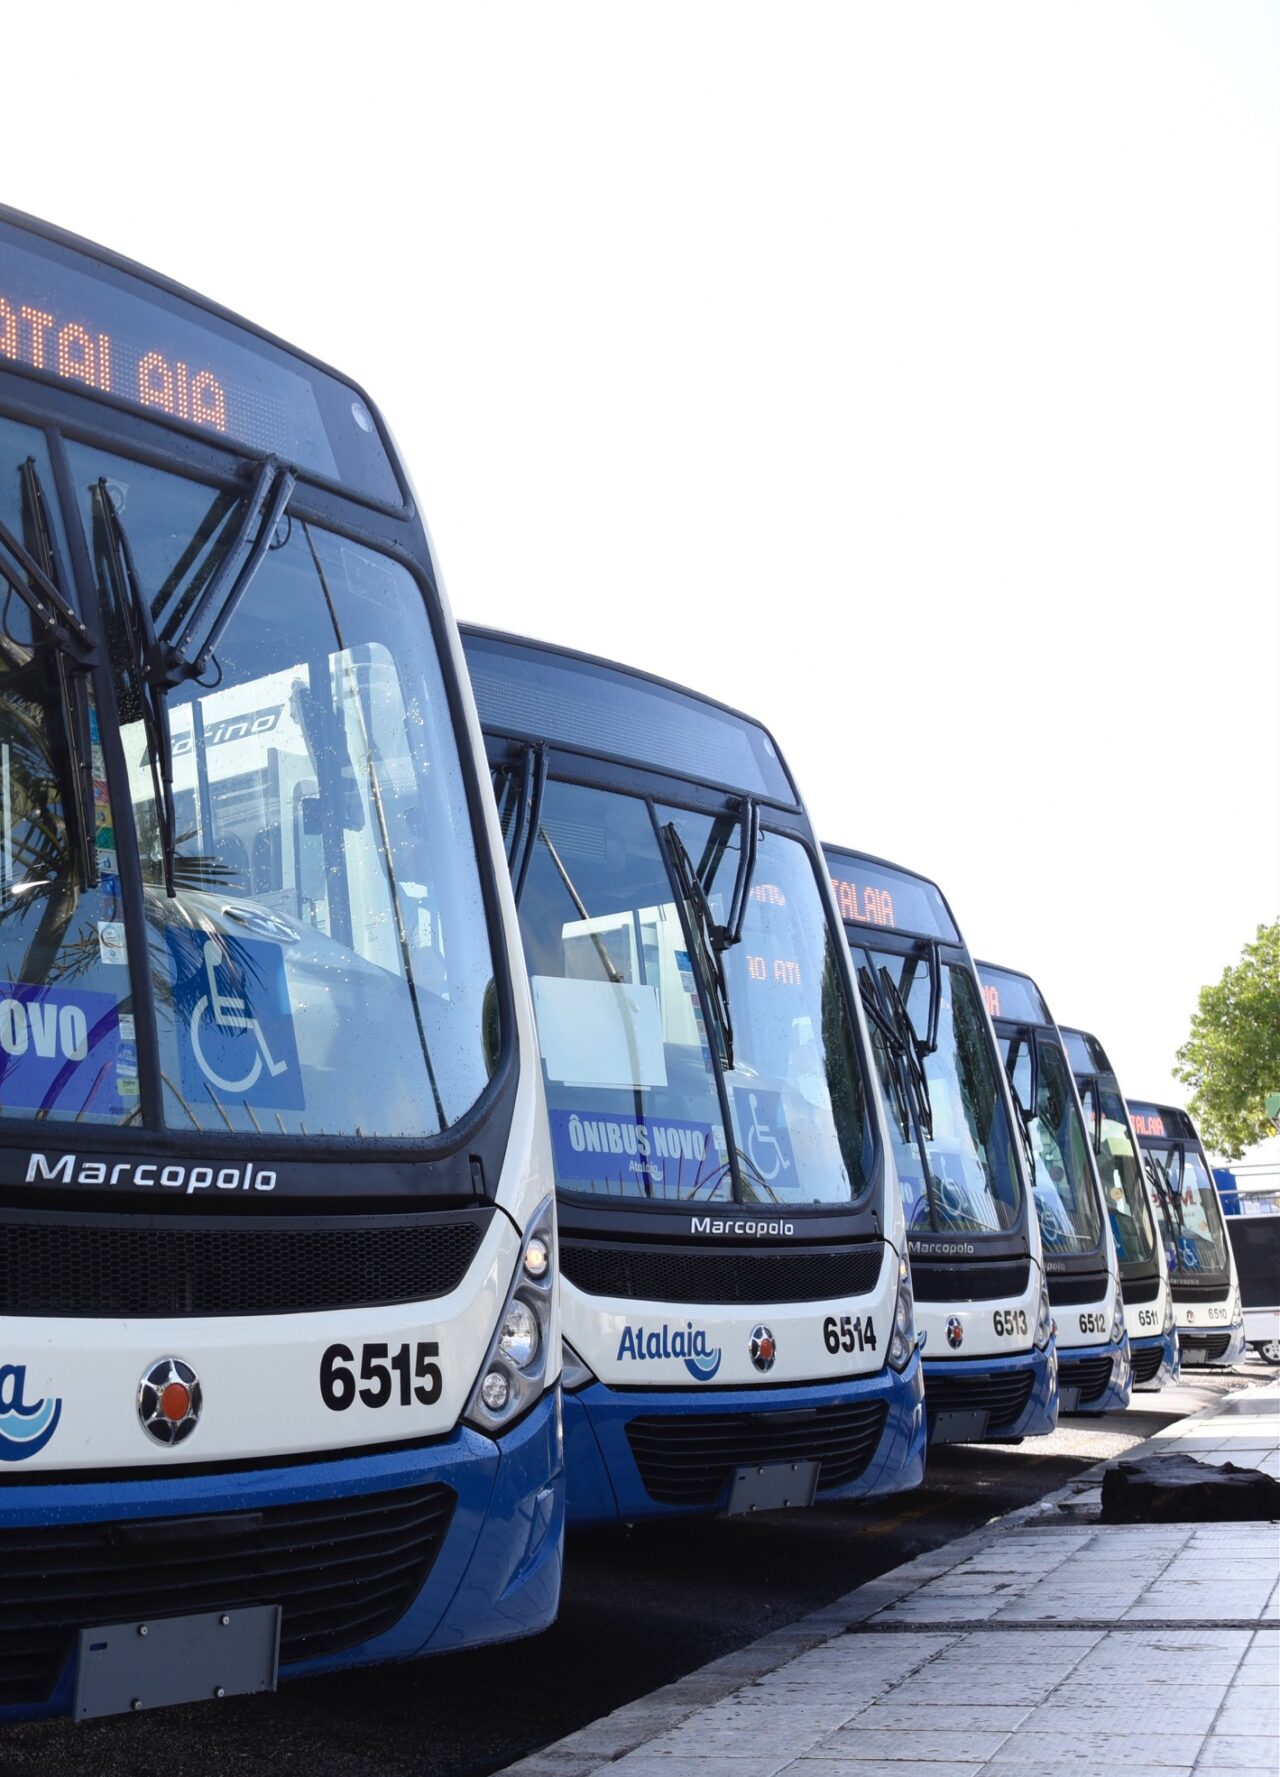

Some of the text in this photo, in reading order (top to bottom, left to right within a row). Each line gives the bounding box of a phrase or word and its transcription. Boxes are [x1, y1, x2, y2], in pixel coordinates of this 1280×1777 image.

[568, 1113, 651, 1158] ÔNIBUS
[652, 1126, 707, 1162] NOVO
[25, 1153, 277, 1194] Marcopolo
[690, 1217, 794, 1238] Marcopolo
[908, 1241, 974, 1255] Marcopolo
[992, 1309, 1028, 1337] 6513
[1079, 1312, 1107, 1334] 6512
[1138, 1309, 1159, 1327] 6511
[1207, 1307, 1228, 1320] 6510
[616, 1321, 715, 1361] Atalaia
[823, 1315, 877, 1355] 6514
[319, 1342, 443, 1412] 6515
